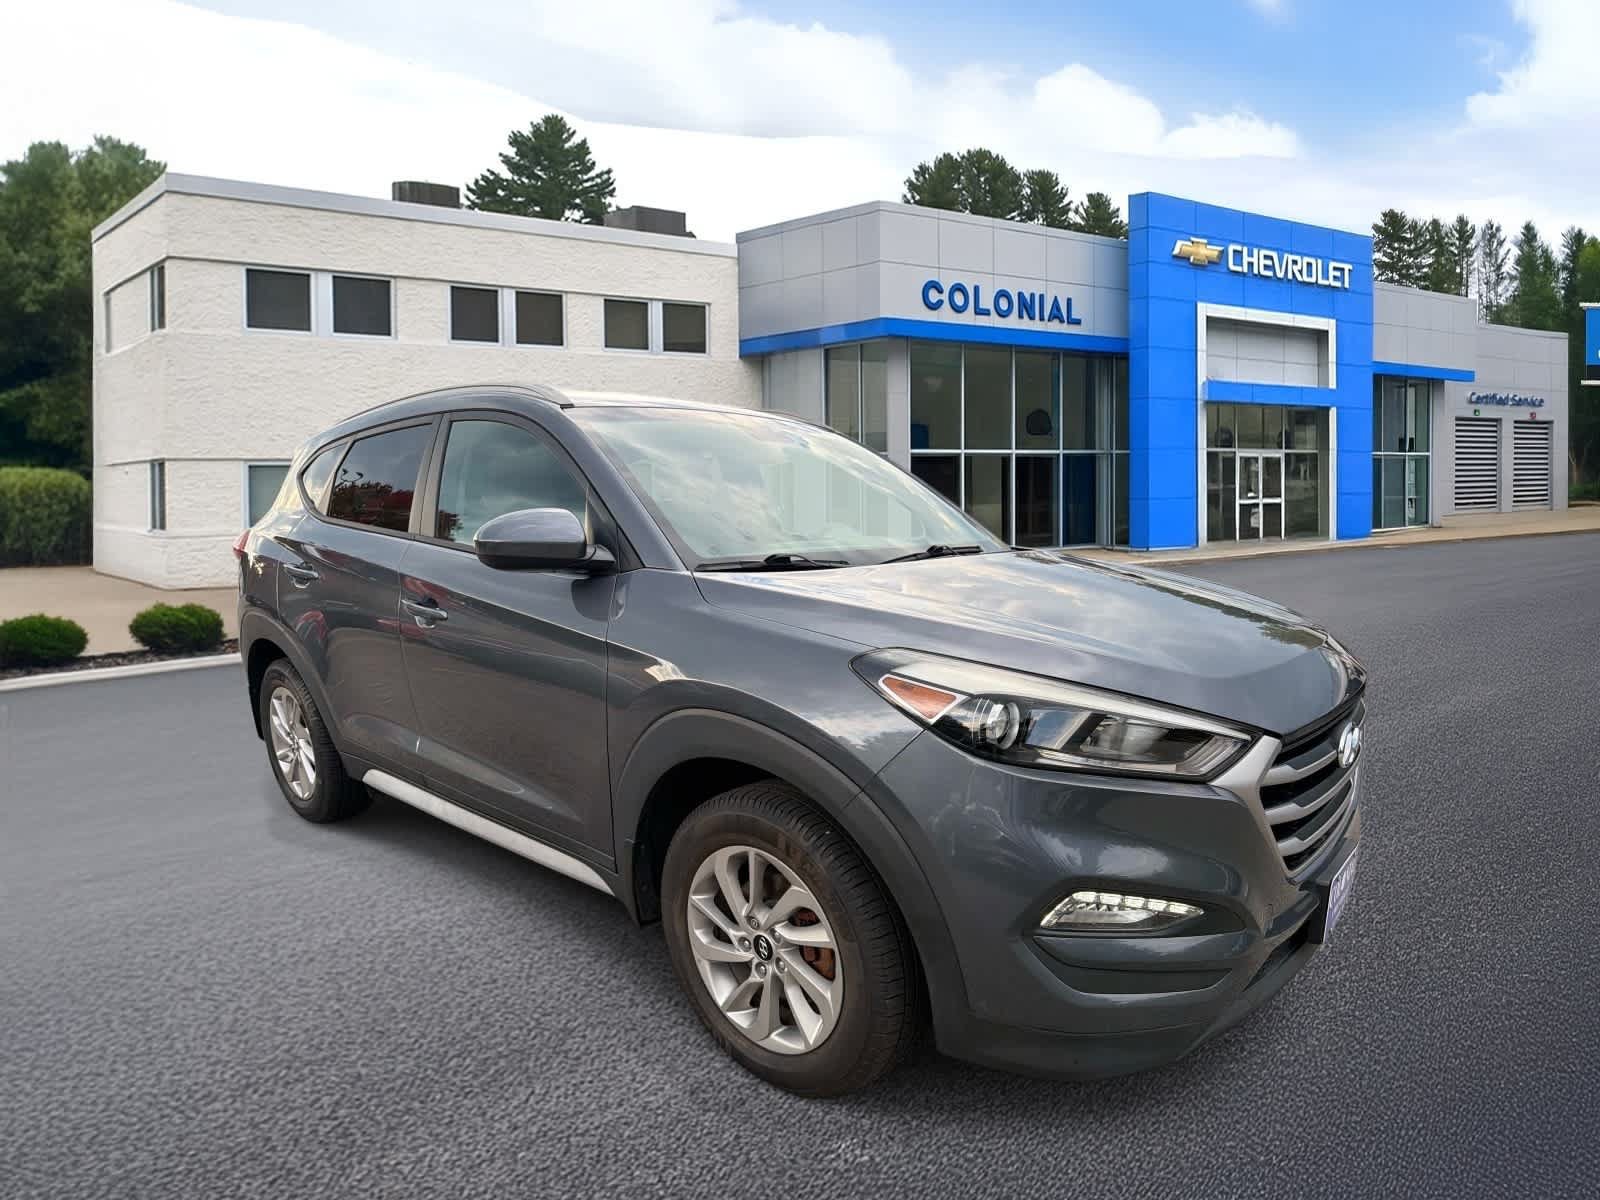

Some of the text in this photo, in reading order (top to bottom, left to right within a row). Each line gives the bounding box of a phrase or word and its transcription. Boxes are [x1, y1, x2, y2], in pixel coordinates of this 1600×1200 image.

[1227, 243, 1353, 290] CHEVROLET
[921, 279, 1082, 326] COLONIAL
[1469, 391, 1544, 408] Certified Service
